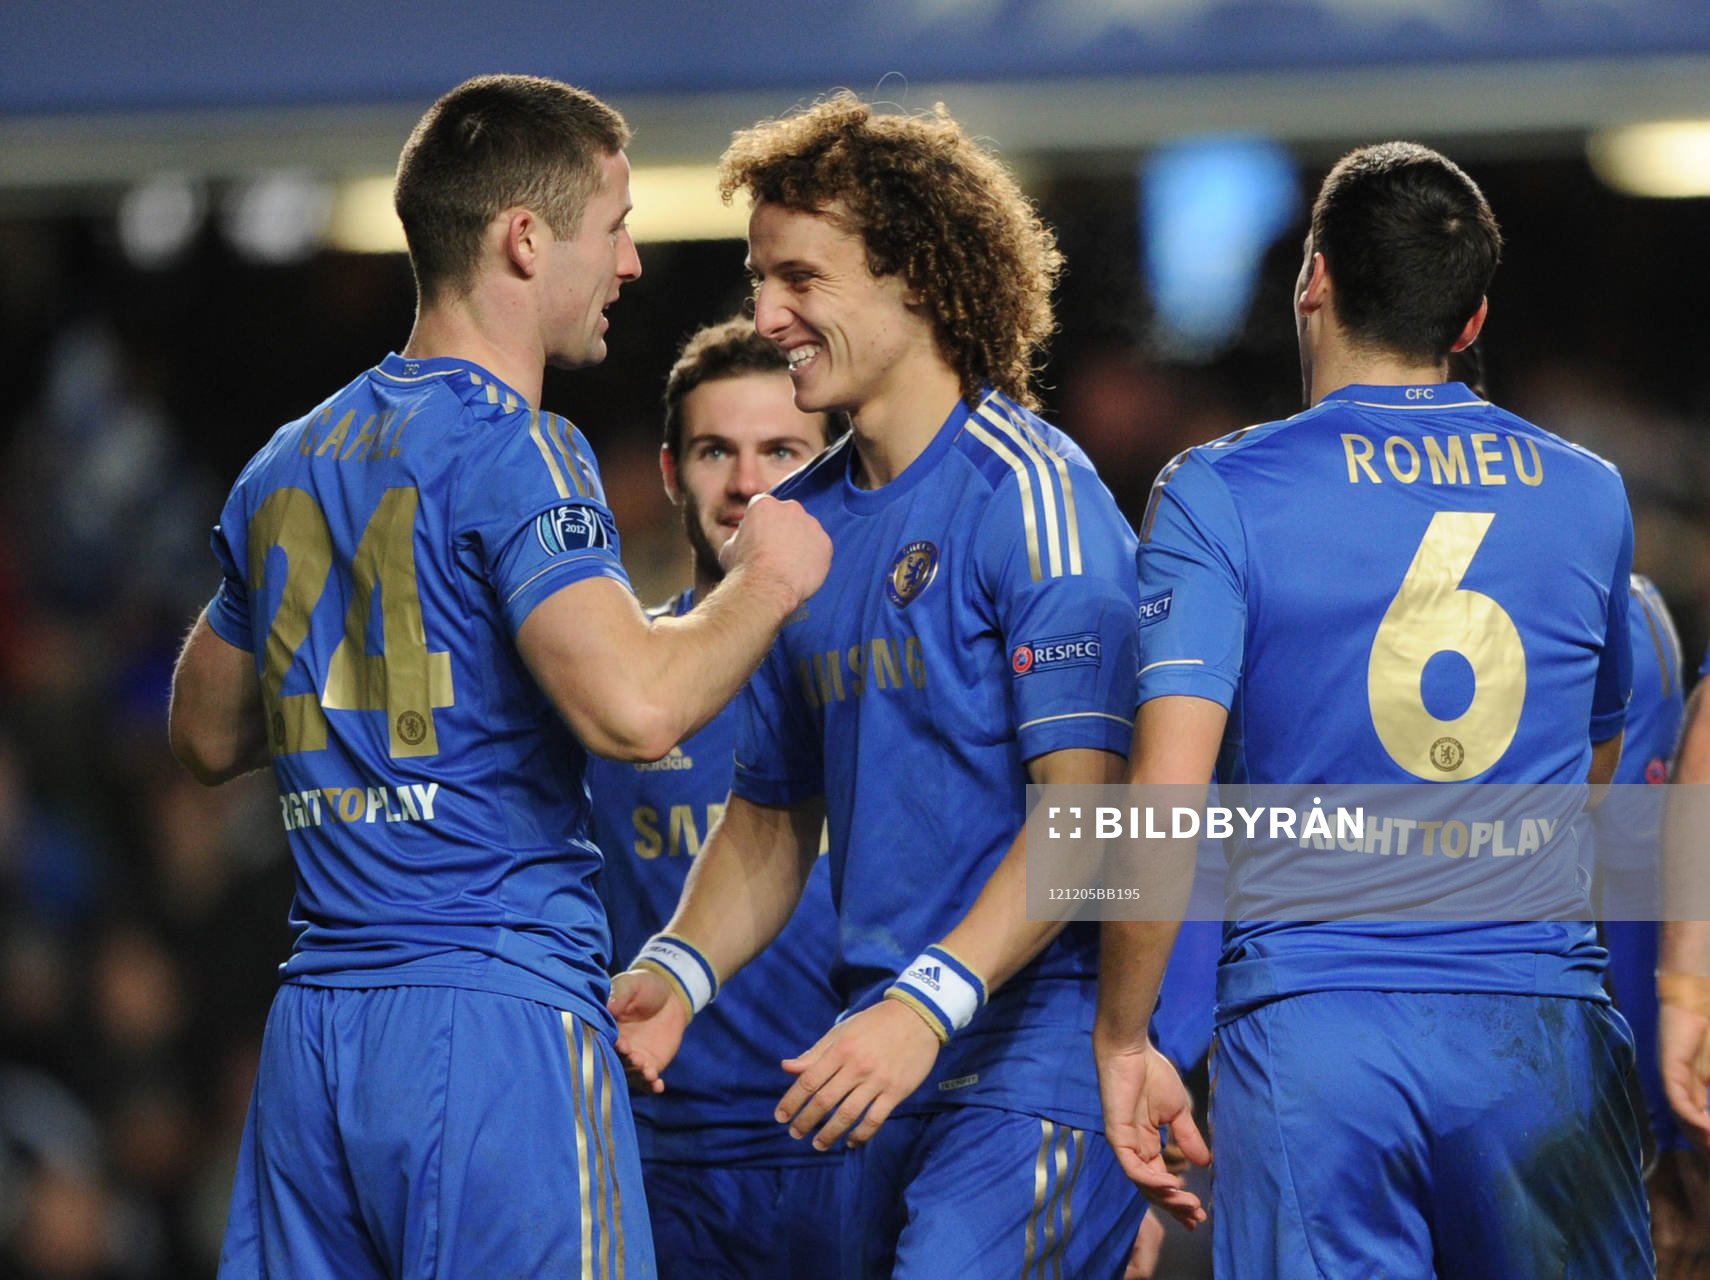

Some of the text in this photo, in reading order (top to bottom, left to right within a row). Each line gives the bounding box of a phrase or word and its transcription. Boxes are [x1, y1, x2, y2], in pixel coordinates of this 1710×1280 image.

[1405, 388, 1434, 400] CFC
[1340, 432, 1545, 487] ROMEU
[565, 523, 586, 534] 2012
[248, 487, 454, 757] 24
[1139, 597, 1171, 620] PECT
[1367, 511, 1527, 782] 6
